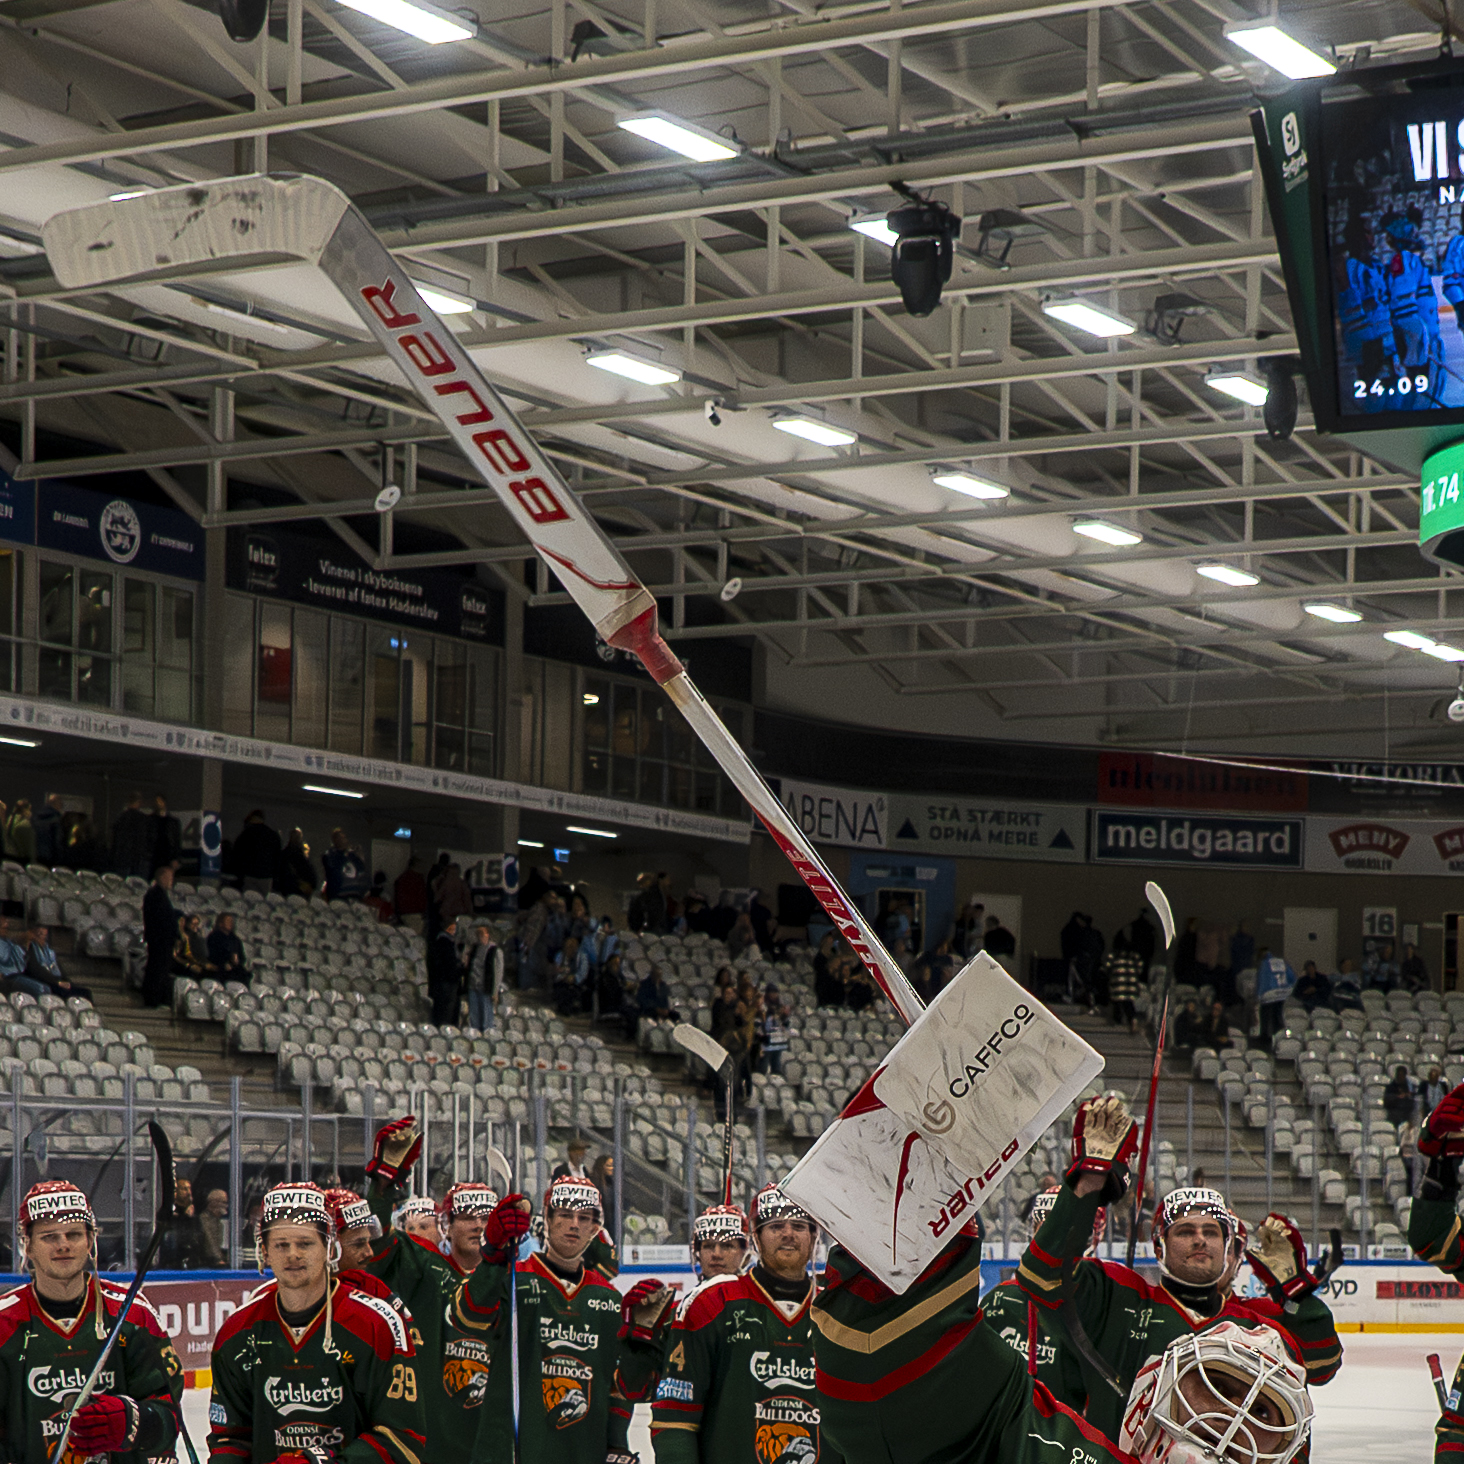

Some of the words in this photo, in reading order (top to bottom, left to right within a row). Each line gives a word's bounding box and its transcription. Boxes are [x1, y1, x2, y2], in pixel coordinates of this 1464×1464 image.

[1407, 121, 1449, 182] VI
[1354, 375, 1429, 398] 24.09
[360, 276, 555, 526] BAUER
[1438, 472, 1459, 507] 74
[788, 791, 883, 845] ABENA
[927, 804, 964, 824] STÅ
[967, 807, 1044, 828] STÆRKT
[928, 822, 982, 844] OPNÅ
[987, 827, 1040, 847] MERE
[1105, 820, 1291, 858] meldgaard
[1338, 826, 1401, 852] MENY
[1365, 912, 1394, 936] 16
[29, 1194, 86, 1212] NEWTEC
[264, 1191, 325, 1206] NEWTEC
[554, 1185, 599, 1200] NEWTEC
[750, 1351, 816, 1384] Carlsber
[387, 1363, 418, 1402] 89
[754, 1401, 821, 1425] BULLDOGS
[275, 1426, 344, 1449] BULLDOGS
